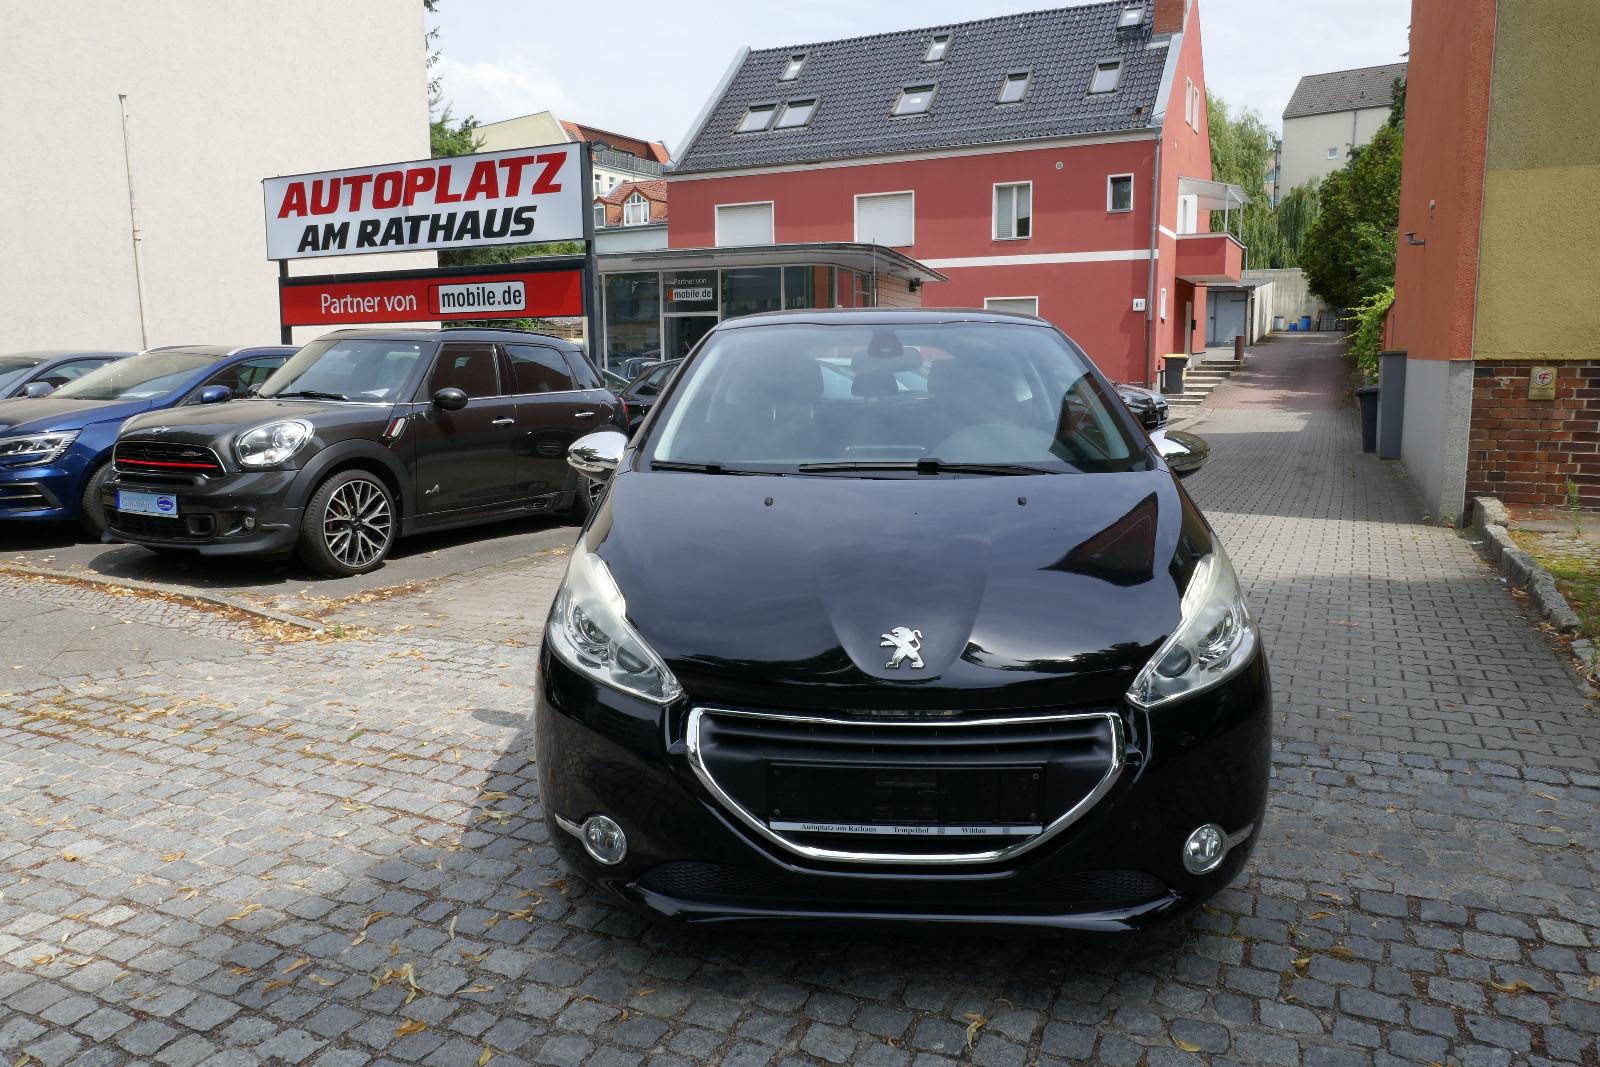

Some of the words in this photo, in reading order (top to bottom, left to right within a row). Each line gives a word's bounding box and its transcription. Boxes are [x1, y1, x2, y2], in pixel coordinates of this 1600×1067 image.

[277, 152, 567, 218] AUTOPLATZ
[297, 221, 350, 252] AM
[356, 205, 537, 248] RATHAUS
[321, 293, 380, 315] Partner
[384, 294, 416, 311] von
[441, 286, 522, 309] mobile.de
[674, 289, 711, 299] mobile.de
[801, 824, 833, 832] Autoplatz
